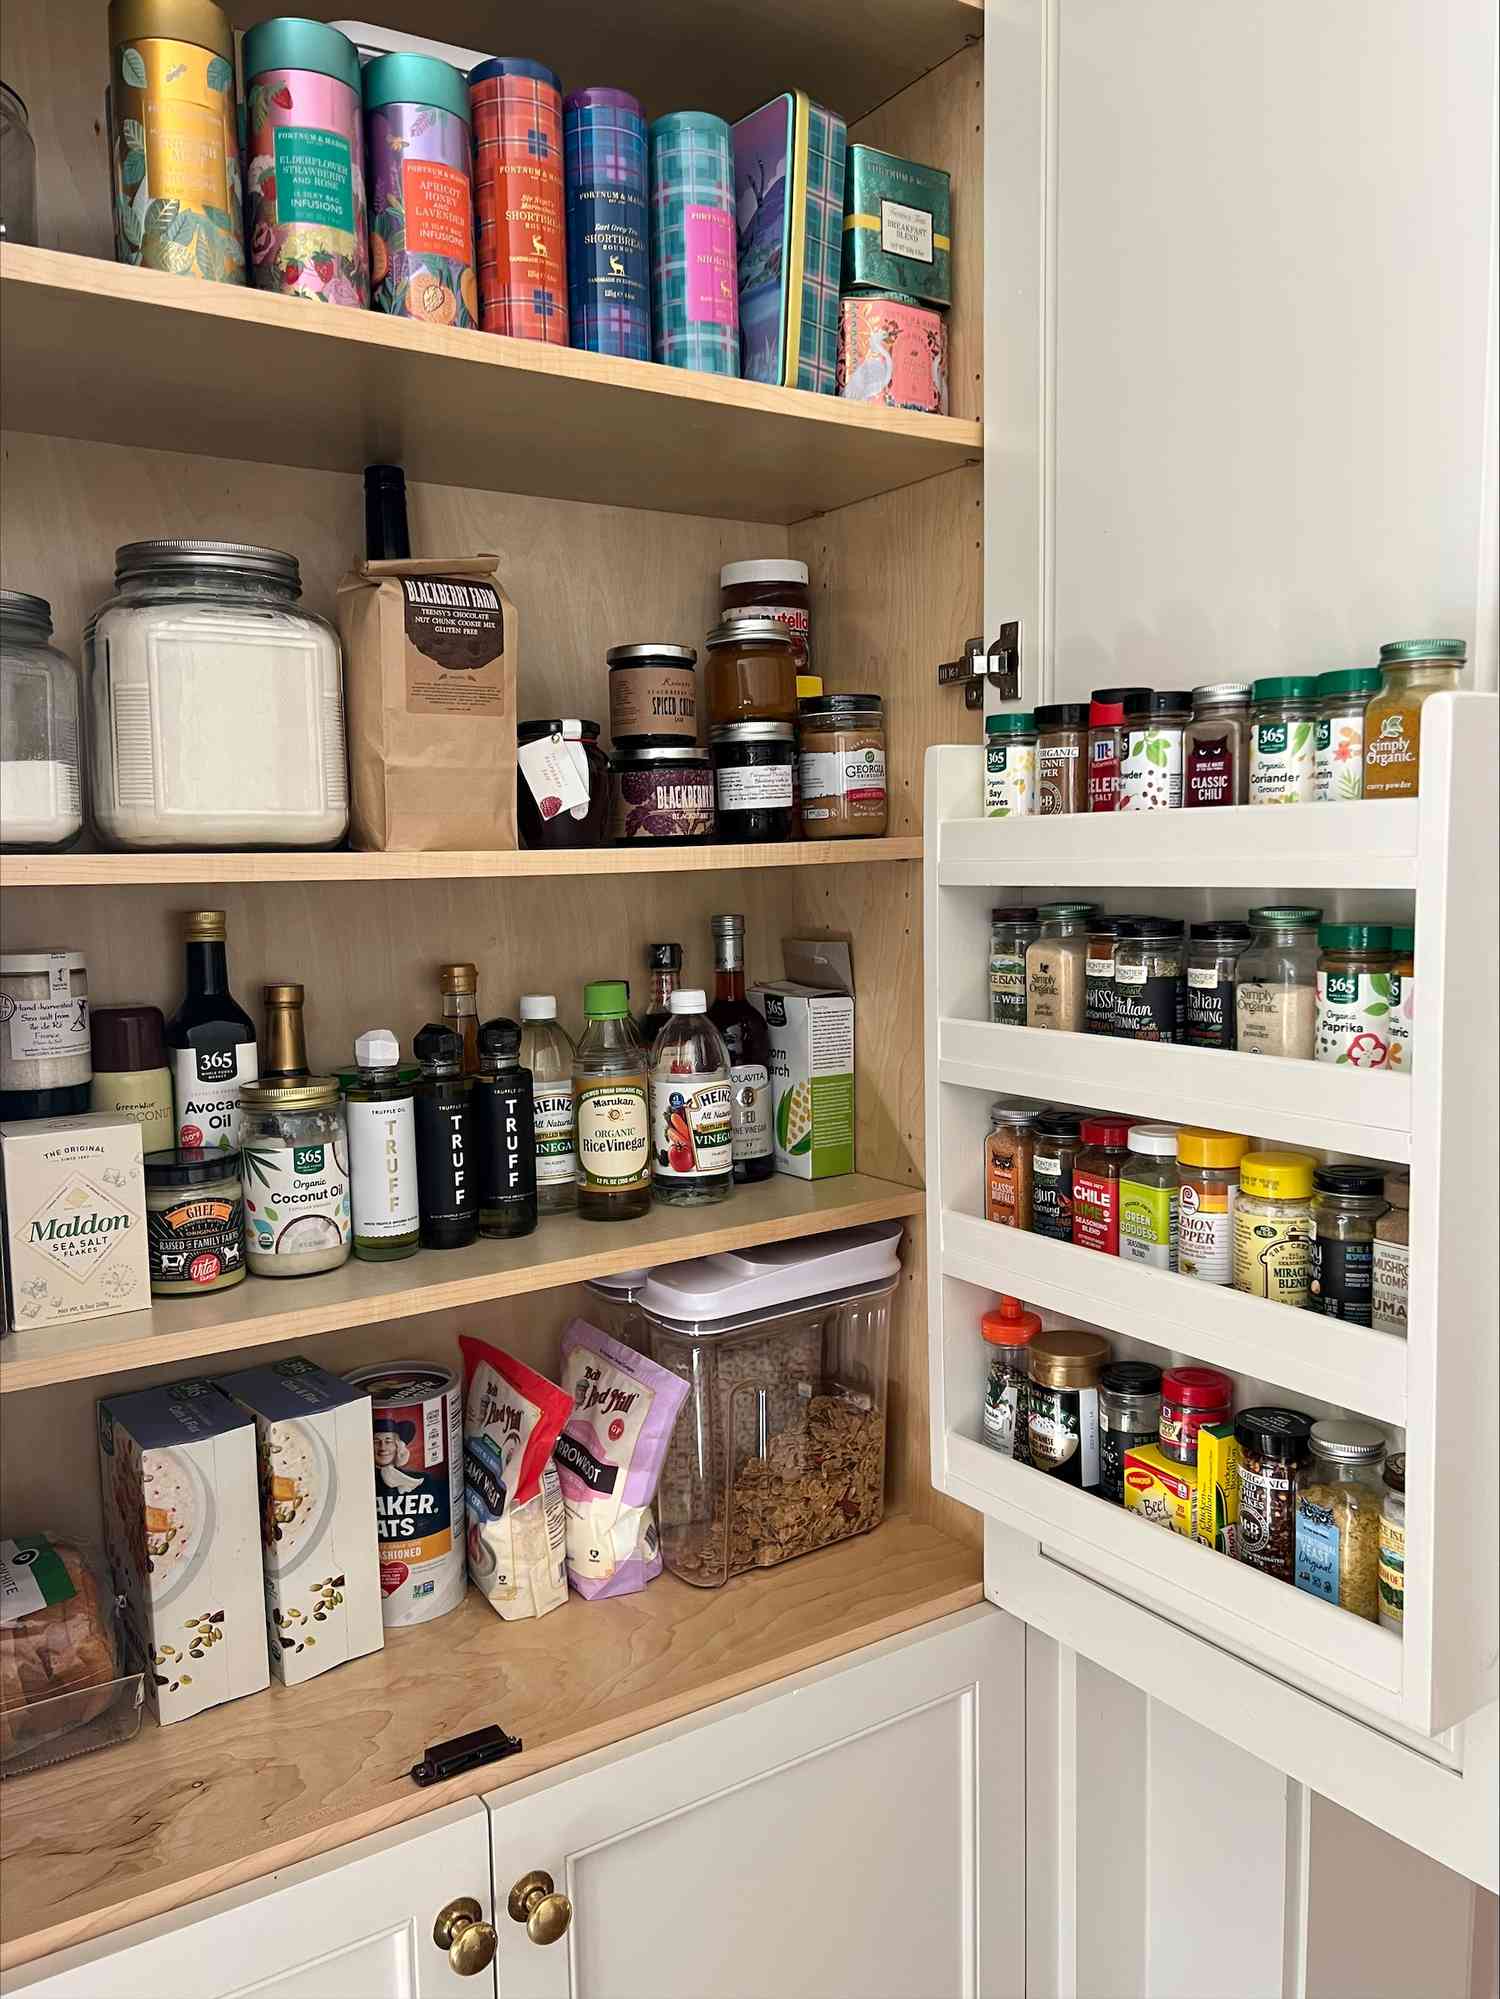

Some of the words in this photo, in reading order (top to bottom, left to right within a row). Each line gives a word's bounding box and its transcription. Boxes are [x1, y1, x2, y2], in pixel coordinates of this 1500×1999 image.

[290, 199, 343, 215] INFUSIONS
[404, 580, 469, 607] BLACKBERRY
[469, 587, 499, 609] FARM
[415, 616, 430, 624] NUT
[434, 626, 462, 635] GLUTEN
[652, 697, 677, 716] SPICED
[1260, 728, 1284, 744] 365
[988, 752, 1004, 765] 365
[1041, 759, 1064, 768] ENNE
[846, 764, 884, 778] GEORGIA
[1251, 773, 1300, 784] Coriander
[1088, 777, 1120, 793] ELER
[1191, 776, 1228, 789] CLASSIC
[989, 789, 1002, 798] Bay
[1198, 787, 1222, 801] CHILI
[999, 976, 1025, 985] ISLAN
[1328, 978, 1355, 993] 365
[767, 1000, 784, 1016] 365
[1322, 1021, 1364, 1034] Paprika
[200, 1051, 232, 1071] 365
[769, 1049, 786, 1060] orn
[769, 1066, 790, 1078] arch
[592, 1097, 636, 1109] Marukan
[700, 1089, 731, 1106] HEINZ
[534, 1099, 572, 1115] HEINZ
[209, 1114, 231, 1129] Oil
[594, 1127, 635, 1138] ORGANIC
[695, 1132, 731, 1145] VINEG
[505, 1100, 519, 1188] TRUFF
[535, 1142, 573, 1154] INEGA
[583, 1138, 605, 1153] Rice
[606, 1137, 646, 1152] Vinegar
[43, 1149, 61, 1160] THE
[64, 1145, 105, 1154] ORIGINAL
[297, 1150, 322, 1165] 365
[451, 1115, 465, 1205] TRUFF
[385, 1119, 400, 1213] TRUFF
[293, 1178, 327, 1190] Organic
[271, 1189, 328, 1204] Coconut
[330, 1184, 343, 1196] Oil
[1035, 1185, 1056, 1204] ajun
[1073, 1186, 1111, 1207] CHILE
[186, 1205, 215, 1218] GHEE
[1125, 1211, 1153, 1227] GREEN
[29, 1213, 130, 1243] Maldon
[1075, 1216, 1108, 1231] SEASONING
[1179, 1216, 1214, 1232] EMON
[1120, 1222, 1158, 1241] GODDESS
[1179, 1230, 1215, 1245] PPER
[53, 1242, 75, 1252] SEA
[80, 1236, 109, 1247] SALT
[160, 1241, 185, 1250] RAISED
[194, 1236, 220, 1248] FAMILY
[64, 1247, 98, 1257] FLAKES
[191, 1258, 218, 1279] Vital
[1274, 1268, 1310, 1279] MIRAC
[1373, 1258, 1408, 1279] MUSHRO
[1380, 1272, 1408, 1291] COMP
[1373, 1298, 1408, 1320] UMA
[1240, 1470, 1289, 1491] ORGANIC
[1243, 1481, 1257, 1491] ED
[1243, 1488, 1261, 1502] HILI
[376, 1495, 434, 1516] AKER
[1243, 1496, 1265, 1510] AKES
[378, 1518, 415, 1537] ATS
[382, 1547, 422, 1560] SHIONED
